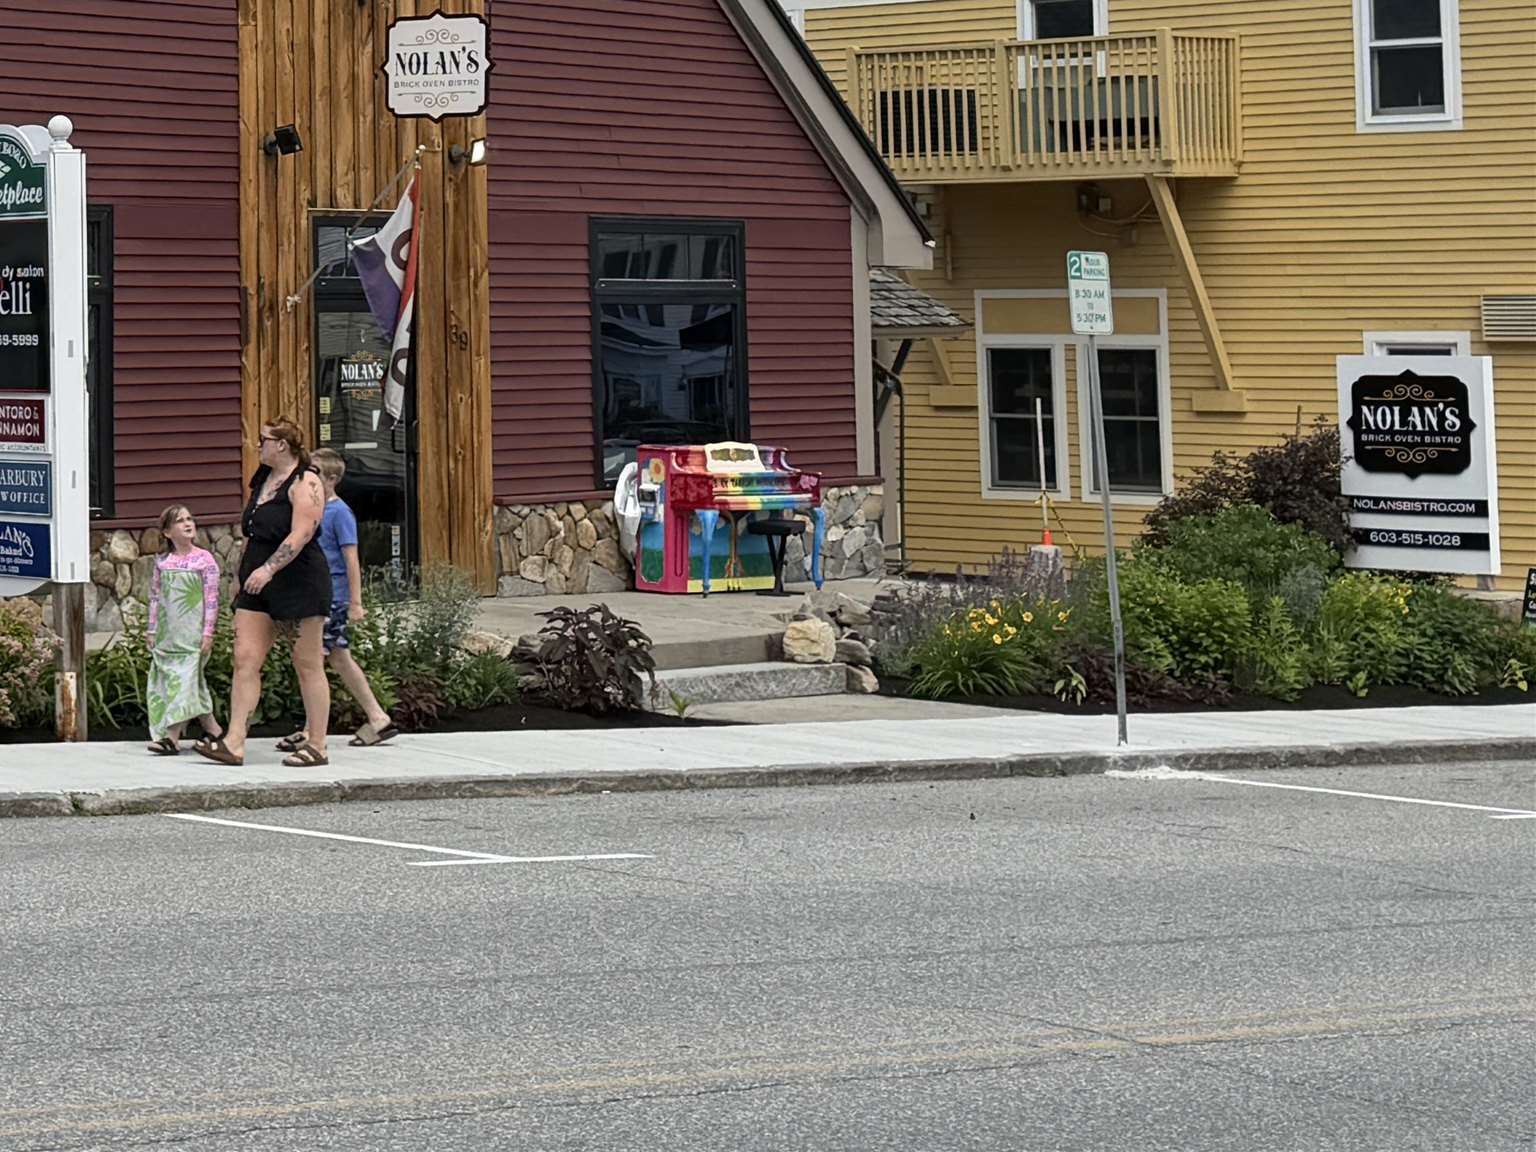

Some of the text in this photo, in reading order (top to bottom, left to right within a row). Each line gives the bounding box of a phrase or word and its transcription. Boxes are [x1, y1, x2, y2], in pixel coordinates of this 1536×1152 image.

[395, 45, 480, 77] NOLAN'S
[394, 79, 480, 89] BRICK OVEN BISTRO
[16, 264, 44, 278] salon
[1070, 256, 1081, 276] 2
[1093, 290, 1105, 299] AM
[341, 361, 384, 381] NOLAN'S
[1360, 402, 1461, 432] NOLAN'S
[1361, 434, 1462, 444] BRICK OVEN BISTRO
[10, 492, 46, 504] OFFICE
[1353, 499, 1476, 513] NOLANSBISTRO.COM
[1369, 532, 1461, 546] 603-515-1028
